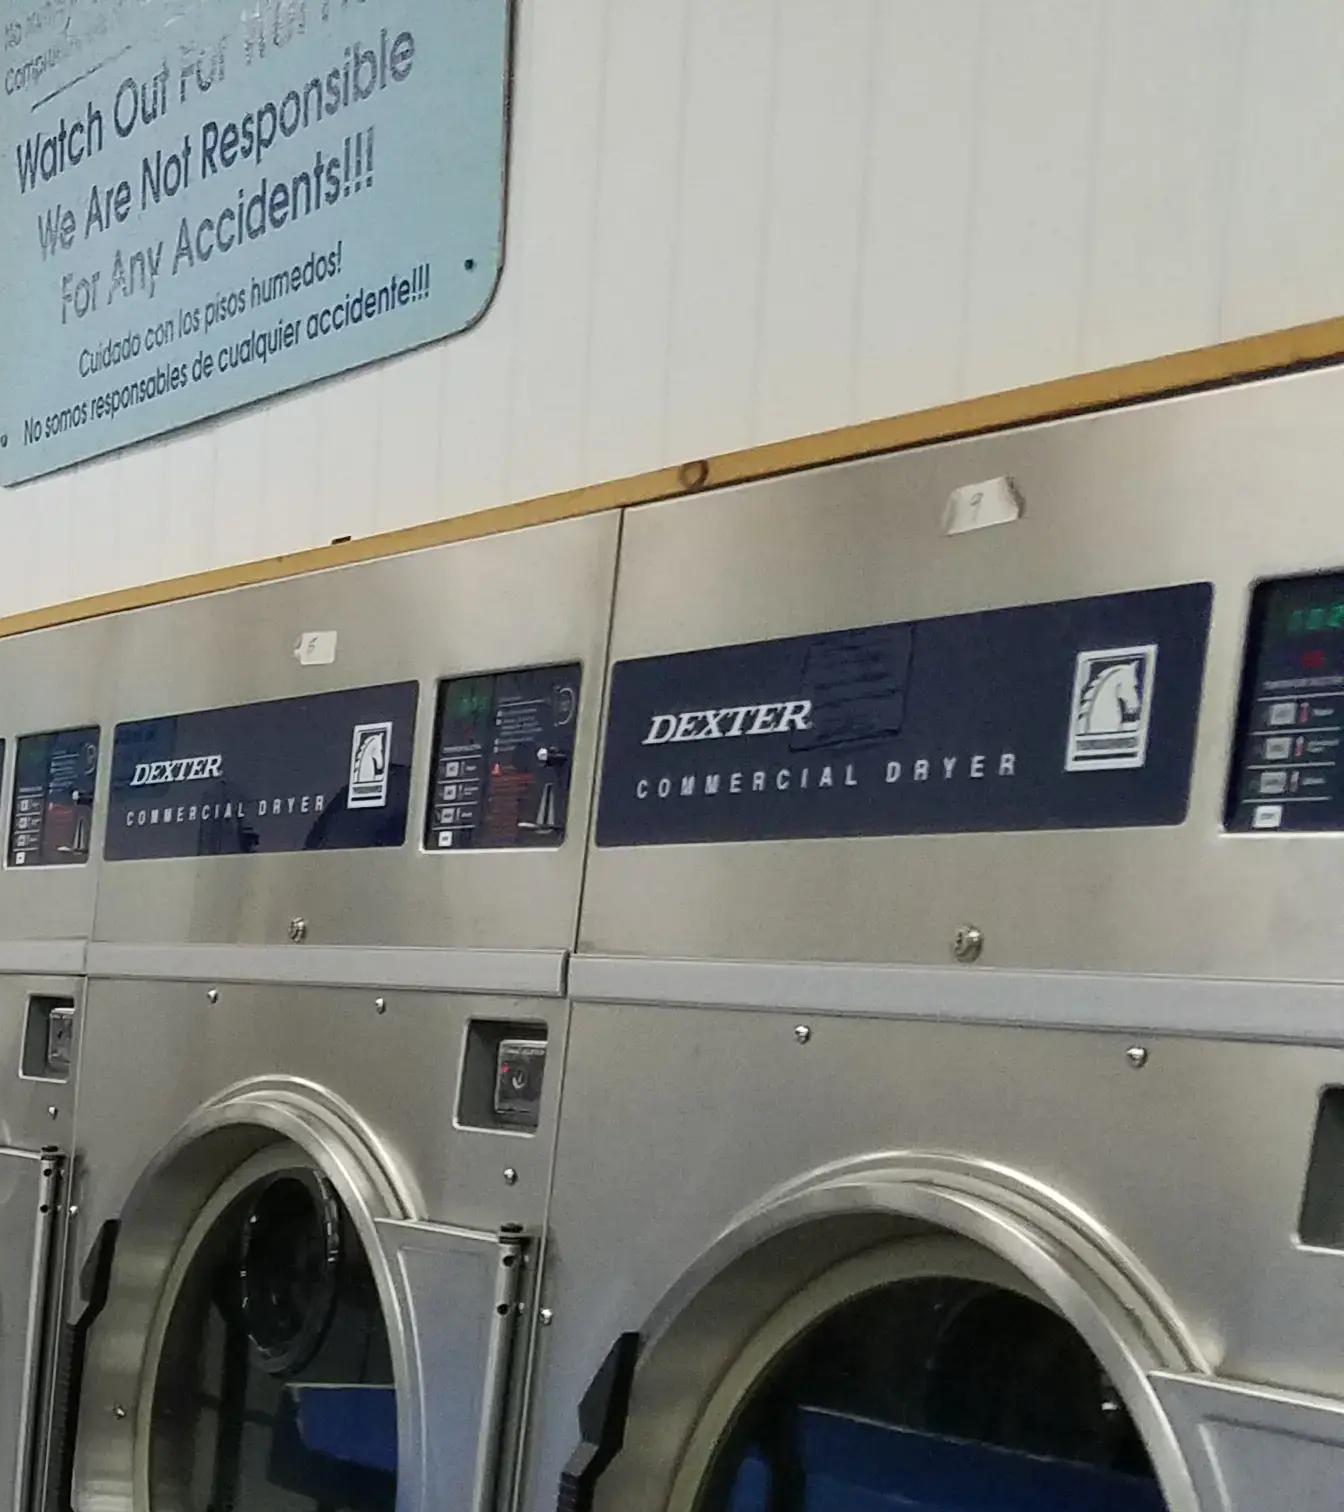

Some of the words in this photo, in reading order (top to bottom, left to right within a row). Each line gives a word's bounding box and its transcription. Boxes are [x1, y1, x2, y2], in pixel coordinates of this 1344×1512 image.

[16, 101, 103, 194] Watch
[113, 60, 169, 138] Out
[37, 204, 75, 262] We
[84, 181, 132, 240] Are
[141, 135, 192, 212] Not
[201, 27, 416, 179] Responsible
[61, 270, 101, 325] For
[107, 240, 164, 306] Any
[171, 124, 375, 277] Accidents!!!
[23, 416, 43, 446] No
[45, 402, 88, 438] somos
[90, 362, 188, 420] responsables
[191, 350, 213, 383] de
[217, 318, 302, 373] cualquier
[306, 263, 431, 341] accidente!!!
[78, 330, 141, 378] Cuidado
[144, 319, 175, 352] con
[178, 308, 200, 339] los
[205, 289, 246, 334] pisos
[250, 240, 343, 309] humedos!
[129, 754, 223, 786] DEXTER
[636, 764, 858, 800] COMMERCIAL
[885, 753, 1017, 783] DRYER
[641, 699, 812, 745] DEXTER
[126, 803, 245, 827] COMMERCIAL
[258, 795, 325, 816] DRYER
